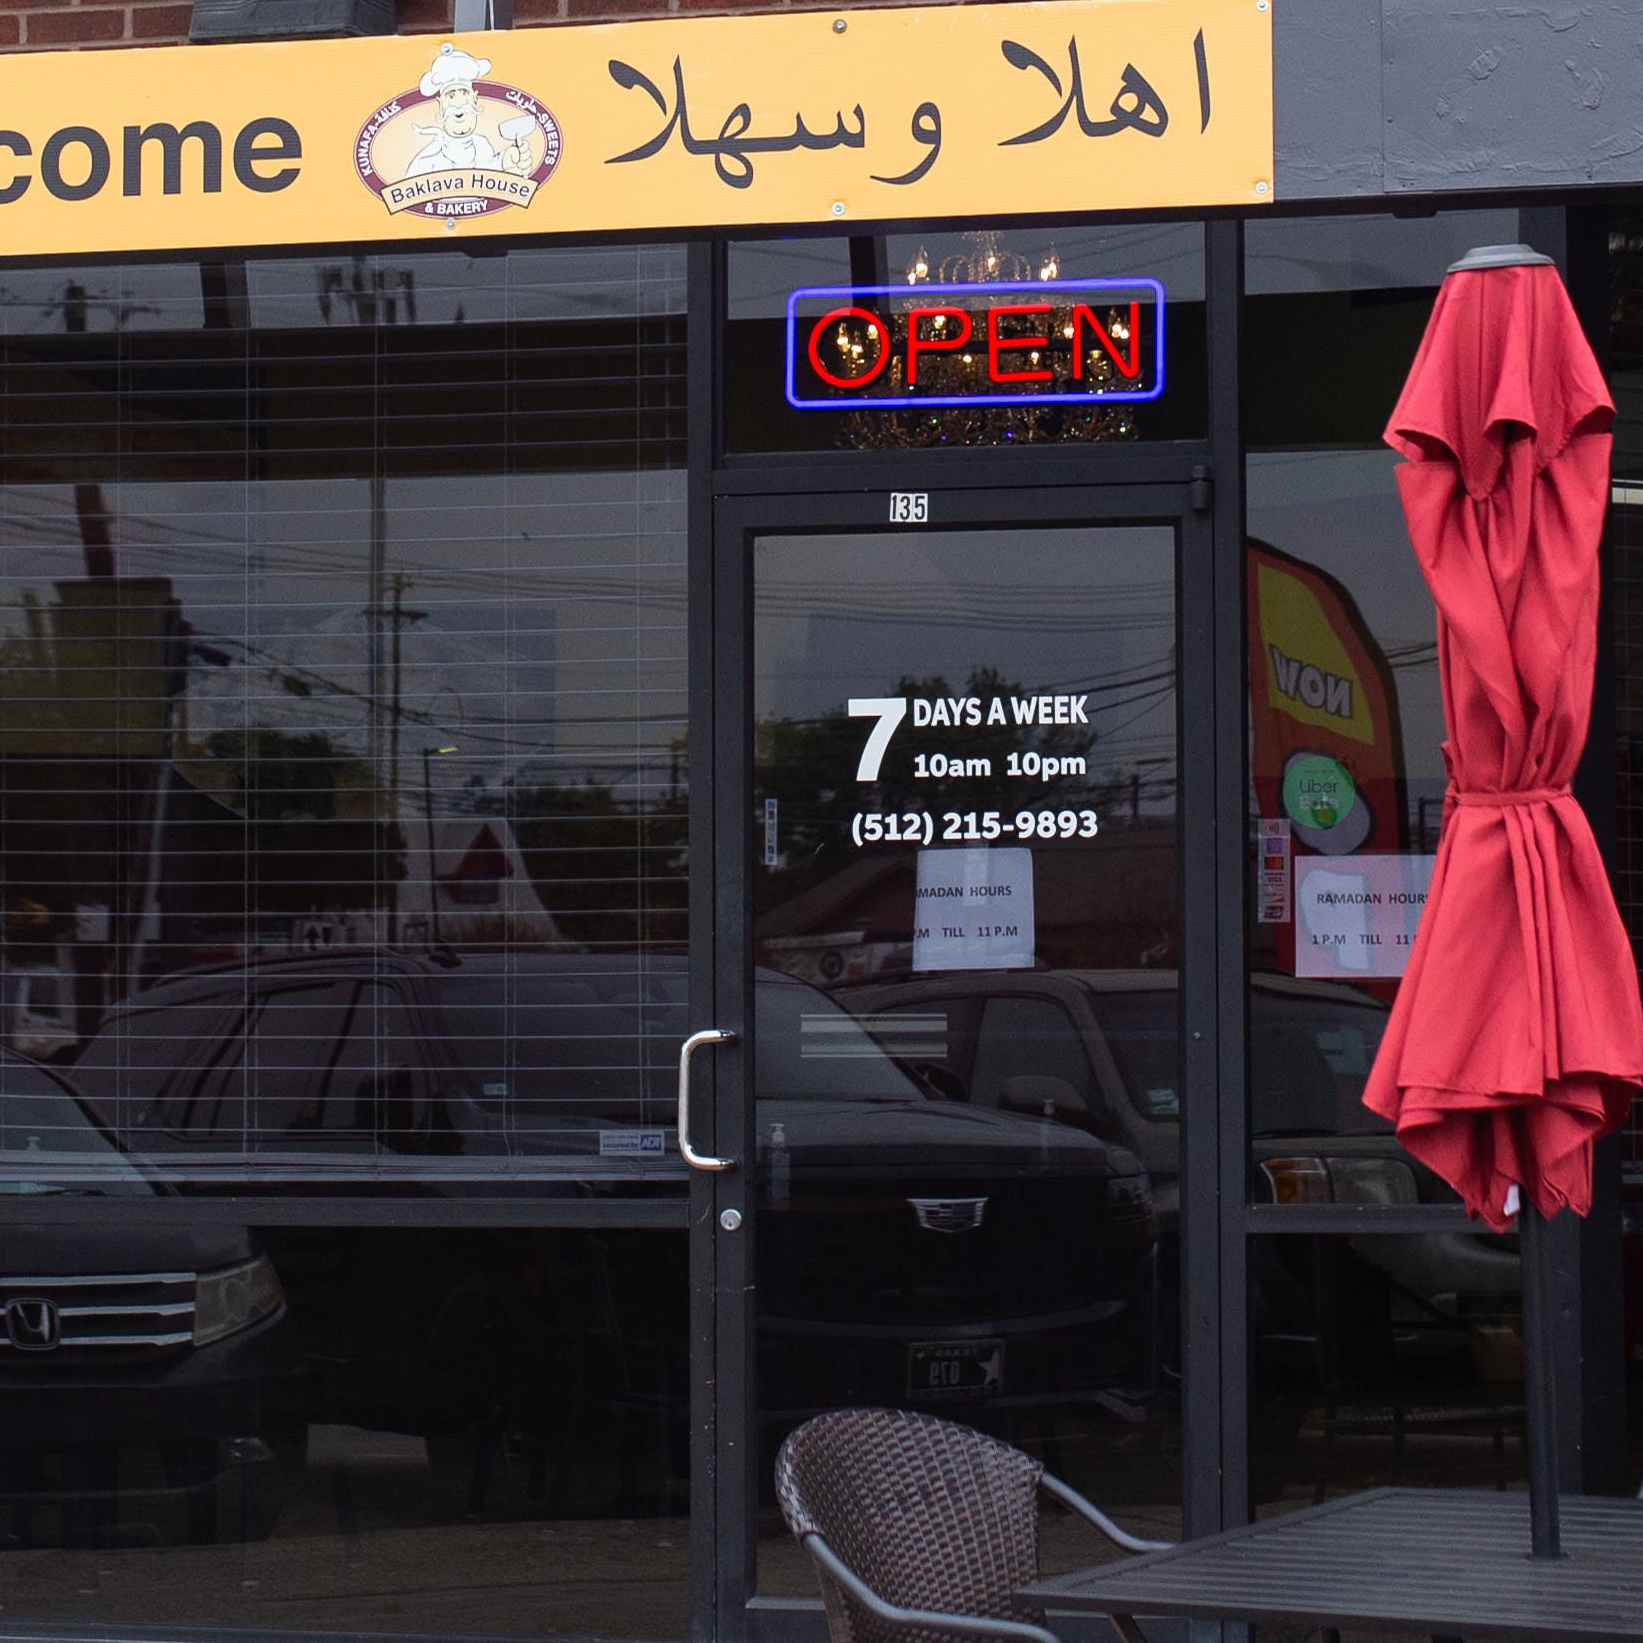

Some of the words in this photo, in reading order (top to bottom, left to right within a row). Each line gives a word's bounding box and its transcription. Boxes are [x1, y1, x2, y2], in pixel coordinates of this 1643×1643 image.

[997, 28, 1210, 147] اهلا
[390, 177, 464, 203] Baklava
[471, 174, 530, 198] House
[424, 202, 433, 214] &
[437, 199, 488, 215] BAKERY
[808, 301, 1140, 389] OPEN
[890, 494, 928, 521] 135
[848, 697, 907, 781] 7
[914, 697, 981, 727] DAYS
[987, 697, 1007, 725] A
[1010, 695, 1089, 724] WEEK
[914, 753, 991, 777] 10am
[1006, 752, 1086, 782] 10pm
[1299, 777, 1338, 794] Uber
[852, 811, 934, 846] (512)
[943, 810, 1098, 840] 215-9893
[970, 886, 1012, 896] HOURS
[1316, 893, 1382, 905] RAMADAN
[942, 927, 965, 938] TILL
[978, 927, 991, 937] 11
[994, 926, 1018, 937] P.M
[1322, 934, 1346, 945] P.M
[1359, 934, 1382, 945] TILL
[1396, 934, 1409, 945] 11
